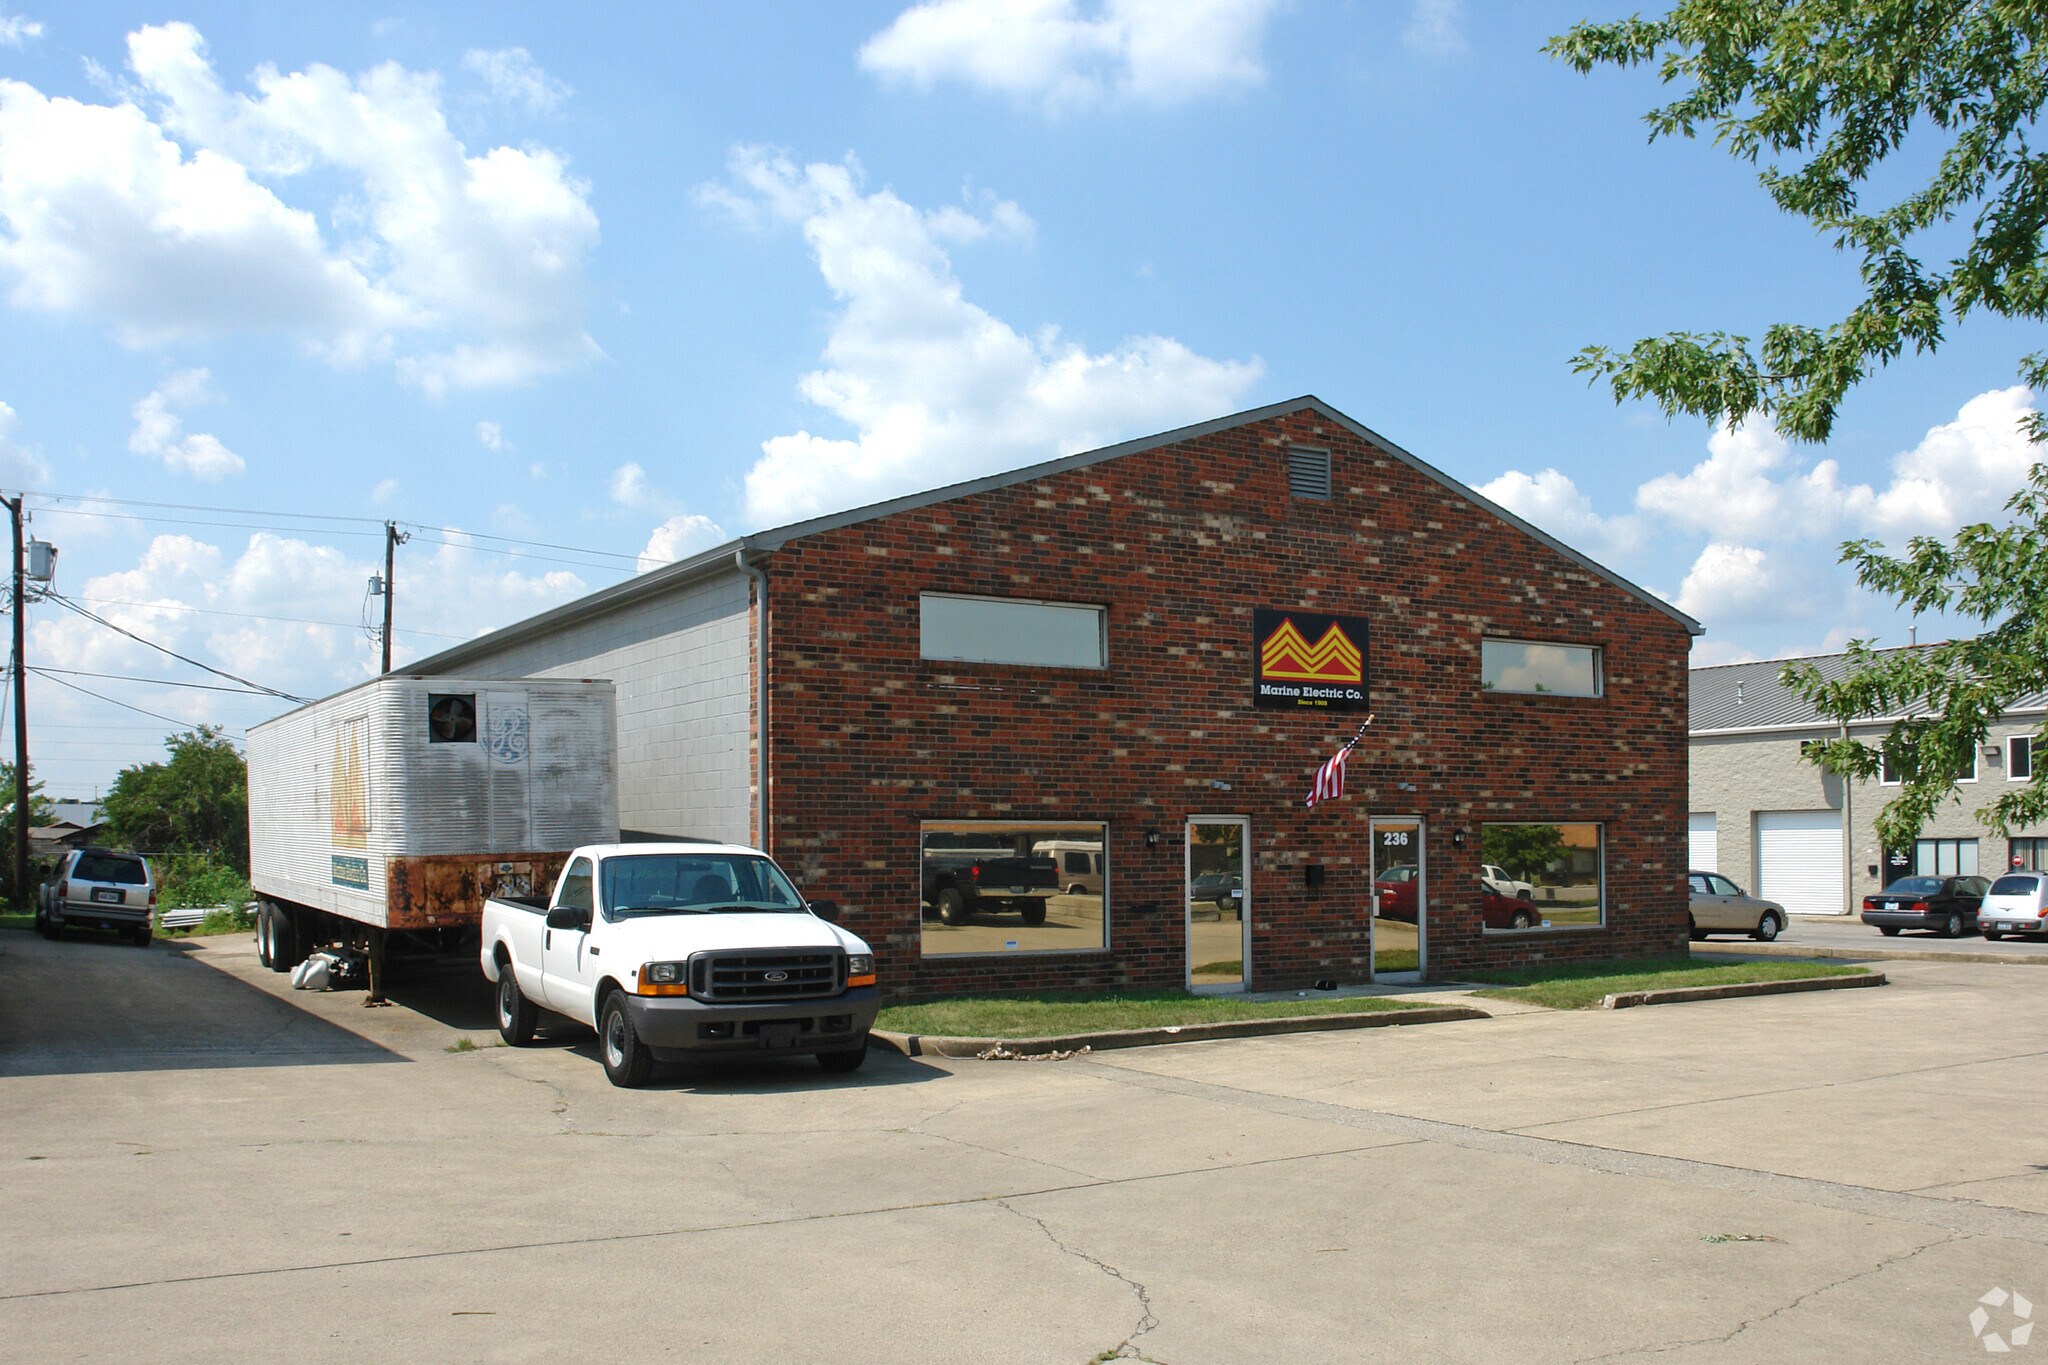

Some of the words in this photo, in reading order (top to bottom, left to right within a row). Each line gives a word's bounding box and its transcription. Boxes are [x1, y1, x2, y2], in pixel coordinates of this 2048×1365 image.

[1260, 684, 1300, 697] Marine
[1302, 686, 1343, 699] Electric
[1345, 688, 1363, 700] Co.
[1383, 832, 1408, 846] 236
